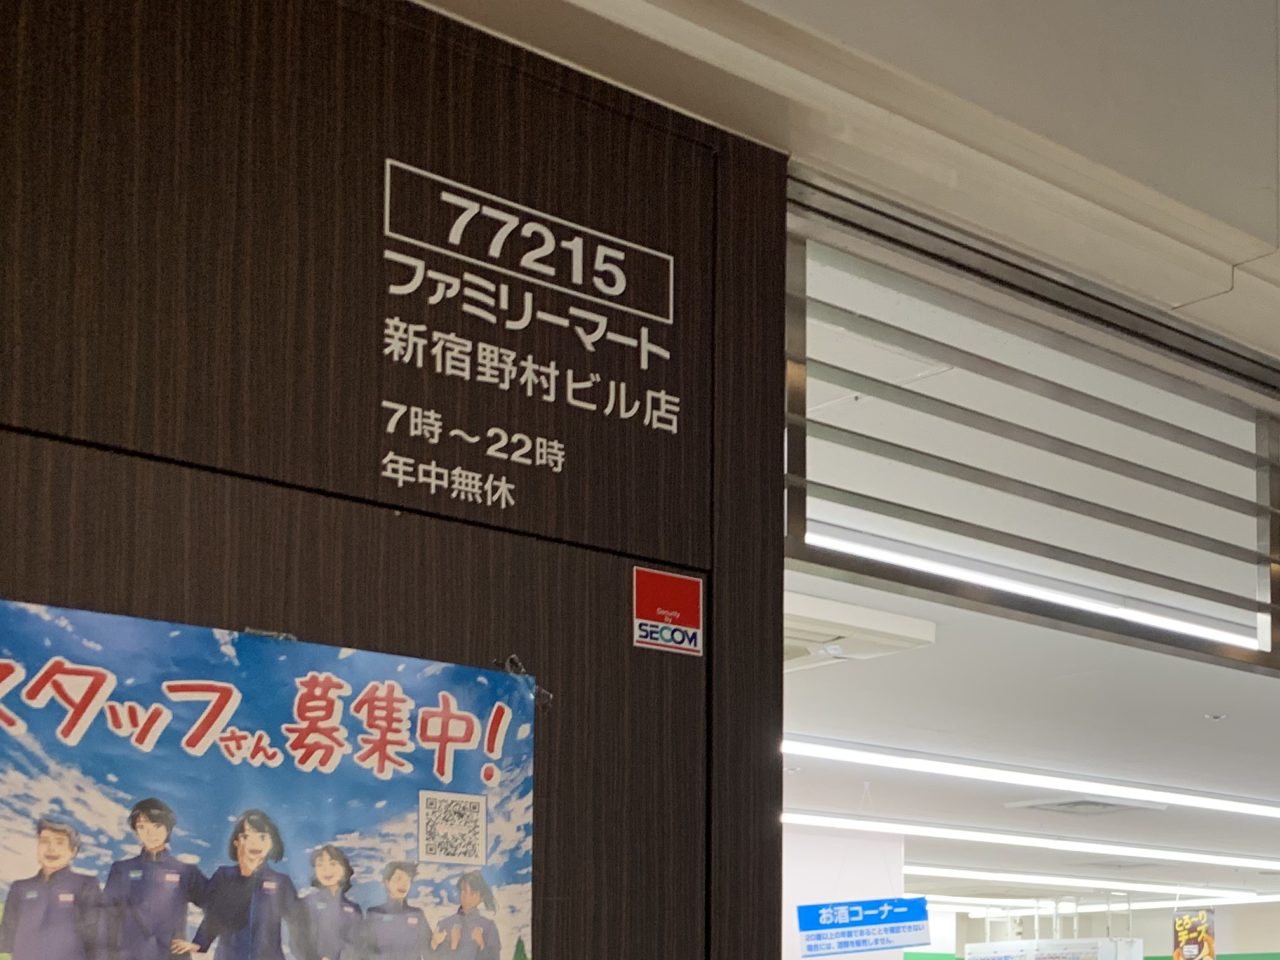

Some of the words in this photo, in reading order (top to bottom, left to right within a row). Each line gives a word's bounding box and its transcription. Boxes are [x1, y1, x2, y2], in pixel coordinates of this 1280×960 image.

[441, 191, 627, 297] 77215
[383, 250, 671, 370] ファミリーマート
[383, 316, 681, 434] 新宿野村ビル店
[381, 452, 516, 509] 年中無休
[638, 622, 698, 648] SECOM
[0, 659, 510, 781] タッフさん募集中!
[818, 903, 908, 924] お酒コーナー
